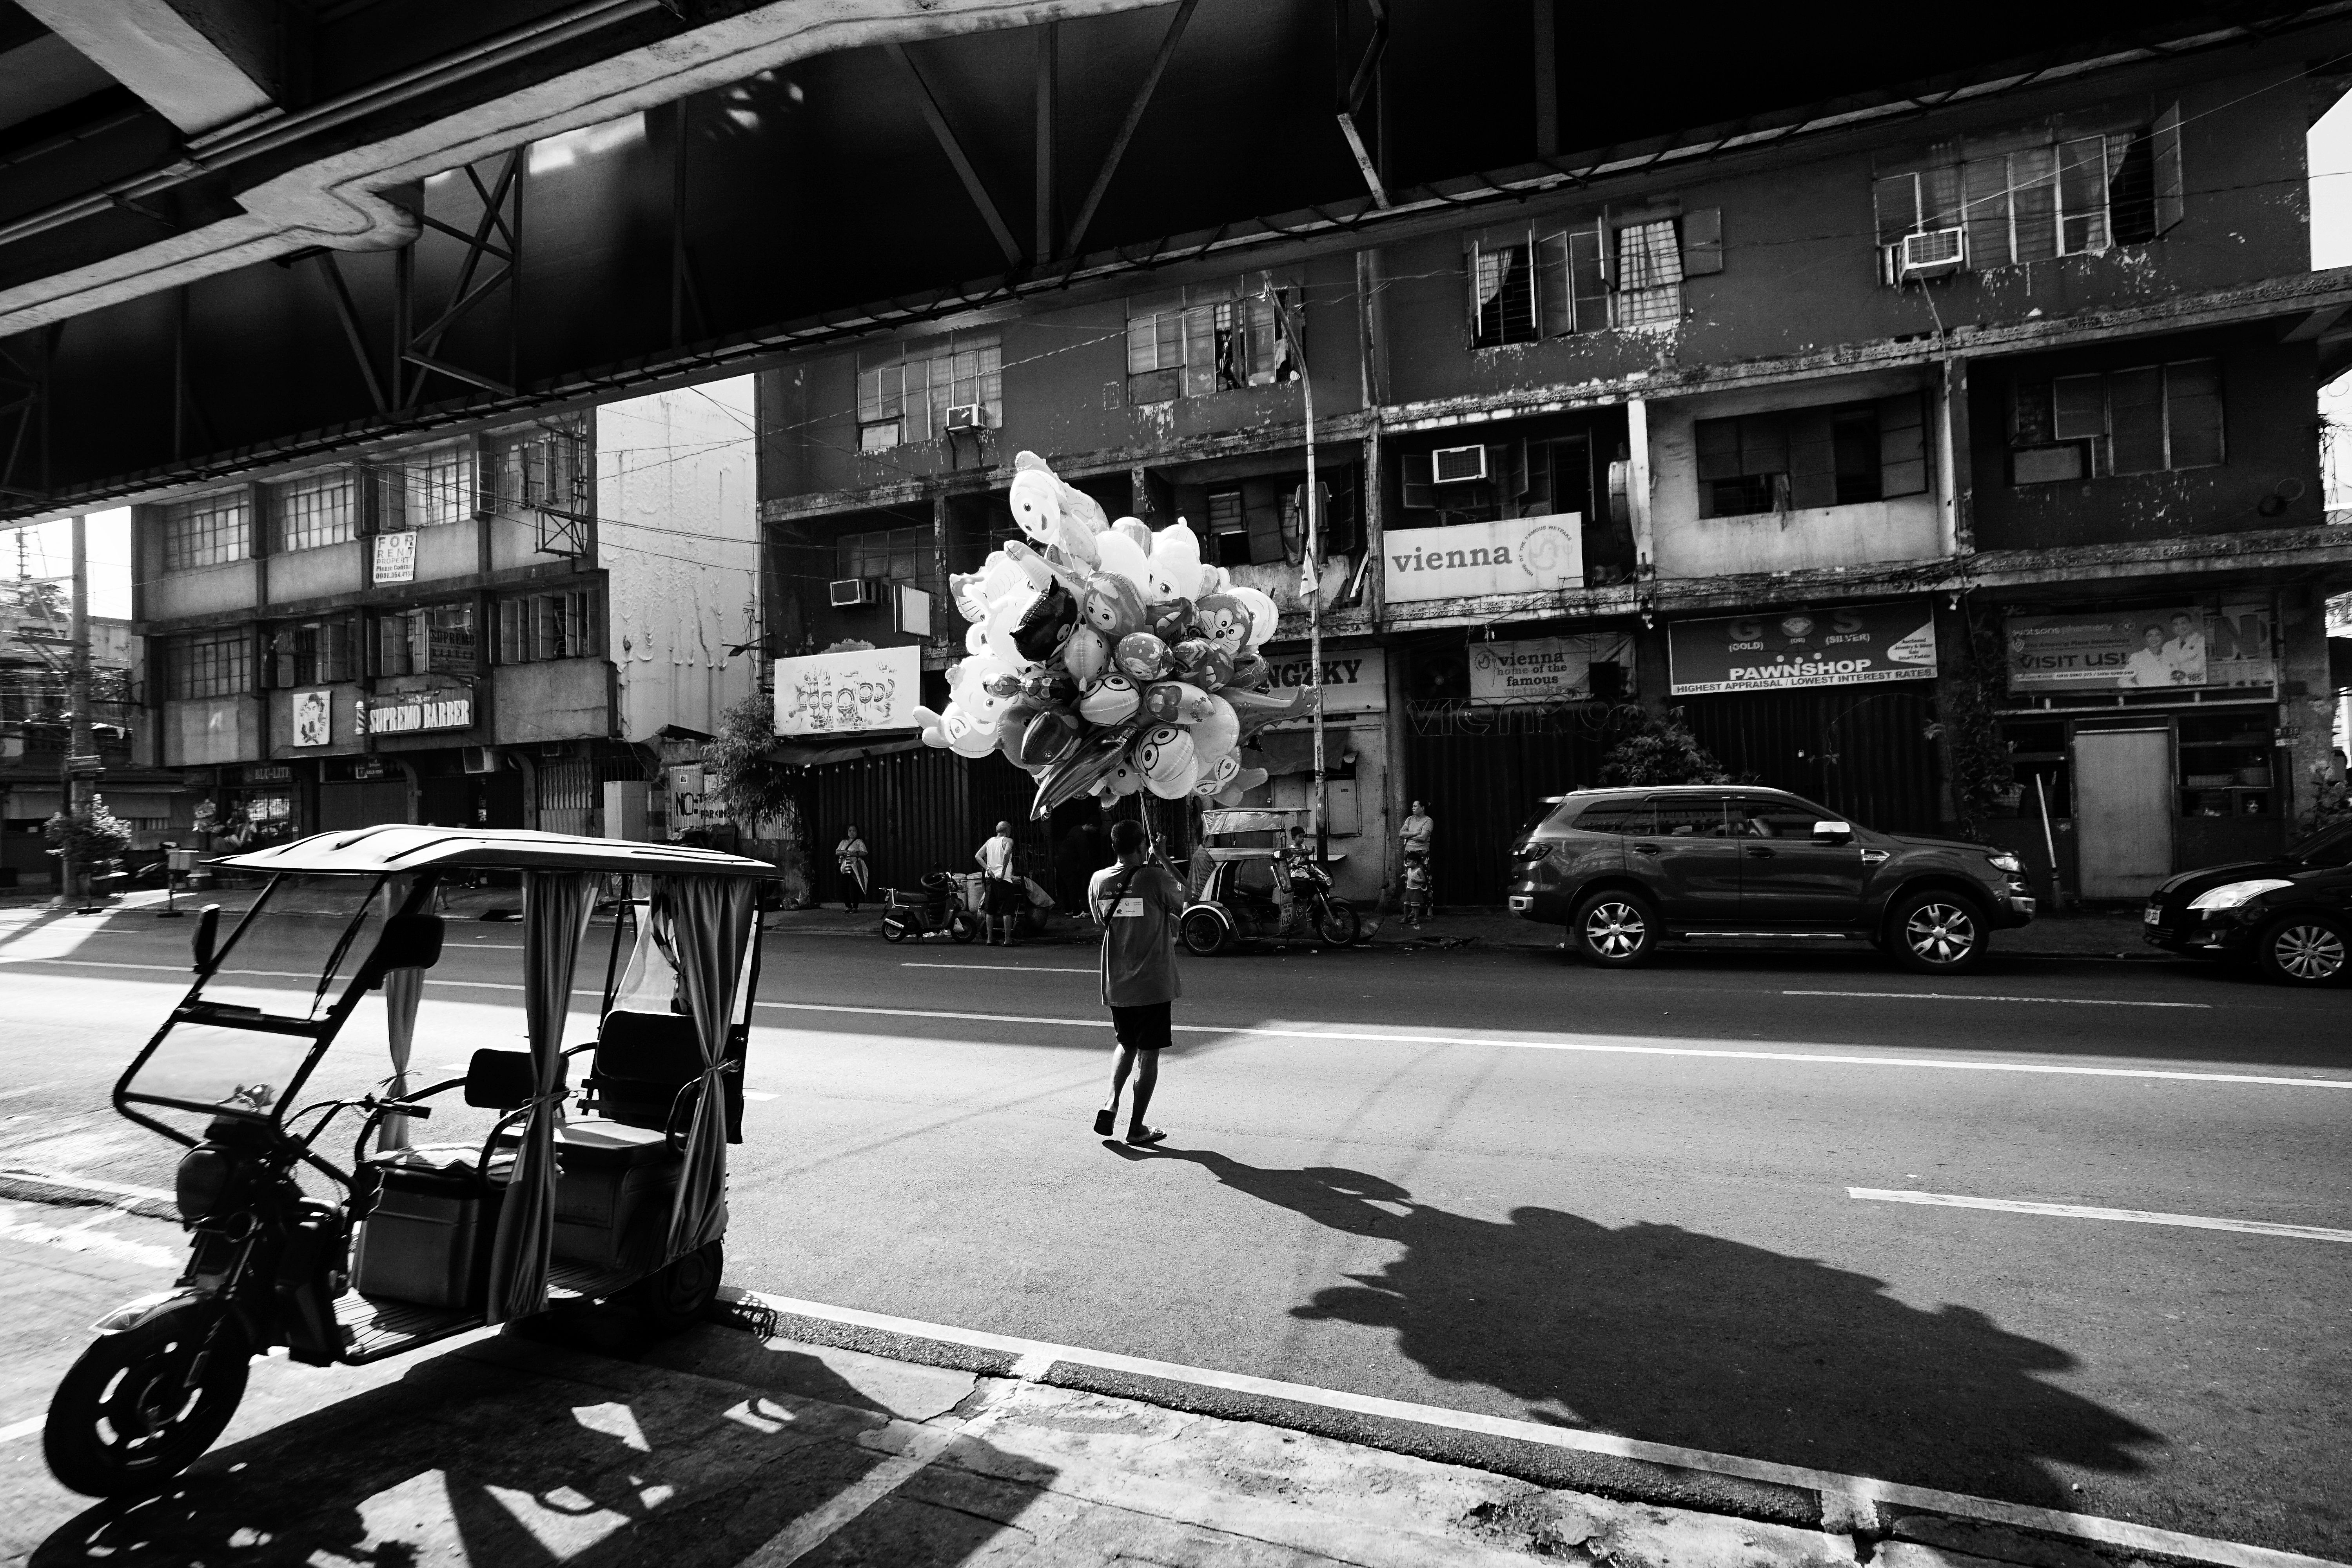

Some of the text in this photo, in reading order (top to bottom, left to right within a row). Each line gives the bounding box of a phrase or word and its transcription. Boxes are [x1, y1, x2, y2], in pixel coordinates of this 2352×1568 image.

[1525, 526, 1546, 540] FAMOUS
[1548, 525, 1572, 541] WETPAKS
[378, 535, 414, 549] FOR
[377, 547, 414, 558] RENT
[1392, 546, 1513, 573] vienna
[1521, 564, 1534, 577] HOME
[1498, 652, 1564, 666] vienna
[2020, 652, 2126, 668] VISIT US!
[1533, 664, 1545, 673] of
[1548, 663, 1567, 672] the
[1730, 659, 1871, 681] PAWNSHOP
[1506, 675, 1559, 686] famous
[1677, 683, 1722, 693] HIGHEST
[1725, 679, 1783, 690] APPRAISAL
[1791, 676, 1835, 686] LOWEST
[1838, 671, 1892, 682] INTEREST
[1895, 668, 1932, 679] RATES
[370, 700, 470, 733] SUPREMO BARBER
